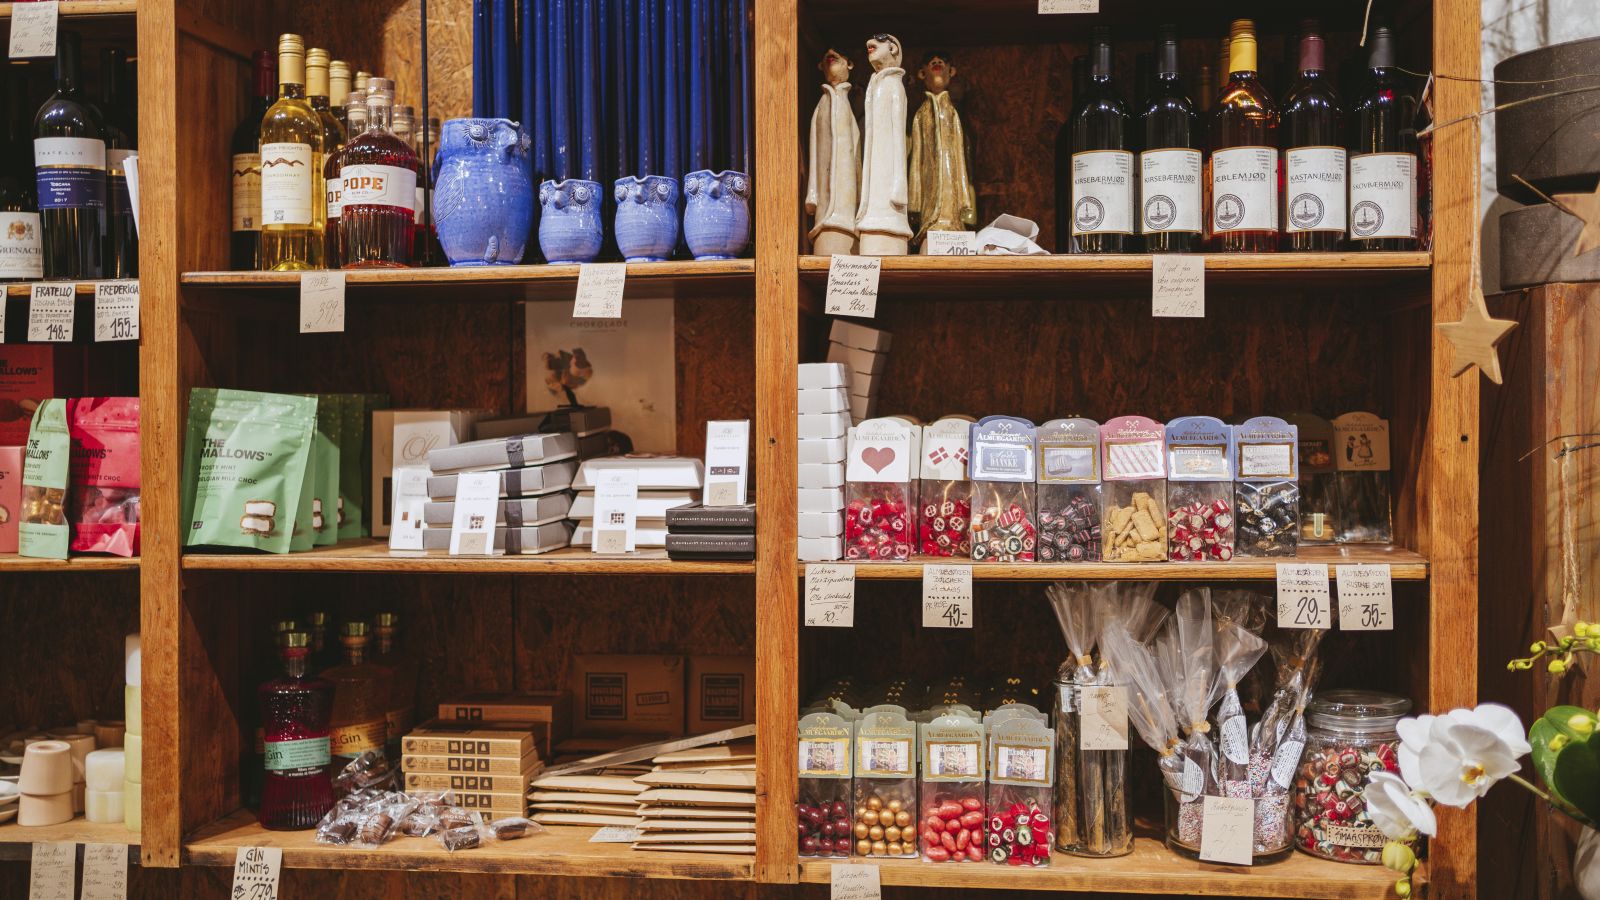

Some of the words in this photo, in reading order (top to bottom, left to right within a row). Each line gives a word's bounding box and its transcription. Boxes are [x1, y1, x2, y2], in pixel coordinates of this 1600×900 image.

[343, 177, 384, 192] POPE
[35, 286, 73, 298] FRATELLO
[46, 323, 69, 340] 148.-
[110, 317, 137, 339] 155.-
[201, 438, 225, 449] THE
[238, 477, 258, 485] CHOC
[942, 603, 968, 627] 45.-
[1294, 596, 1327, 626] 29.-
[1361, 603, 1387, 628] 35.-
[340, 733, 362, 745] Gin
[246, 848, 264, 862] GIN
